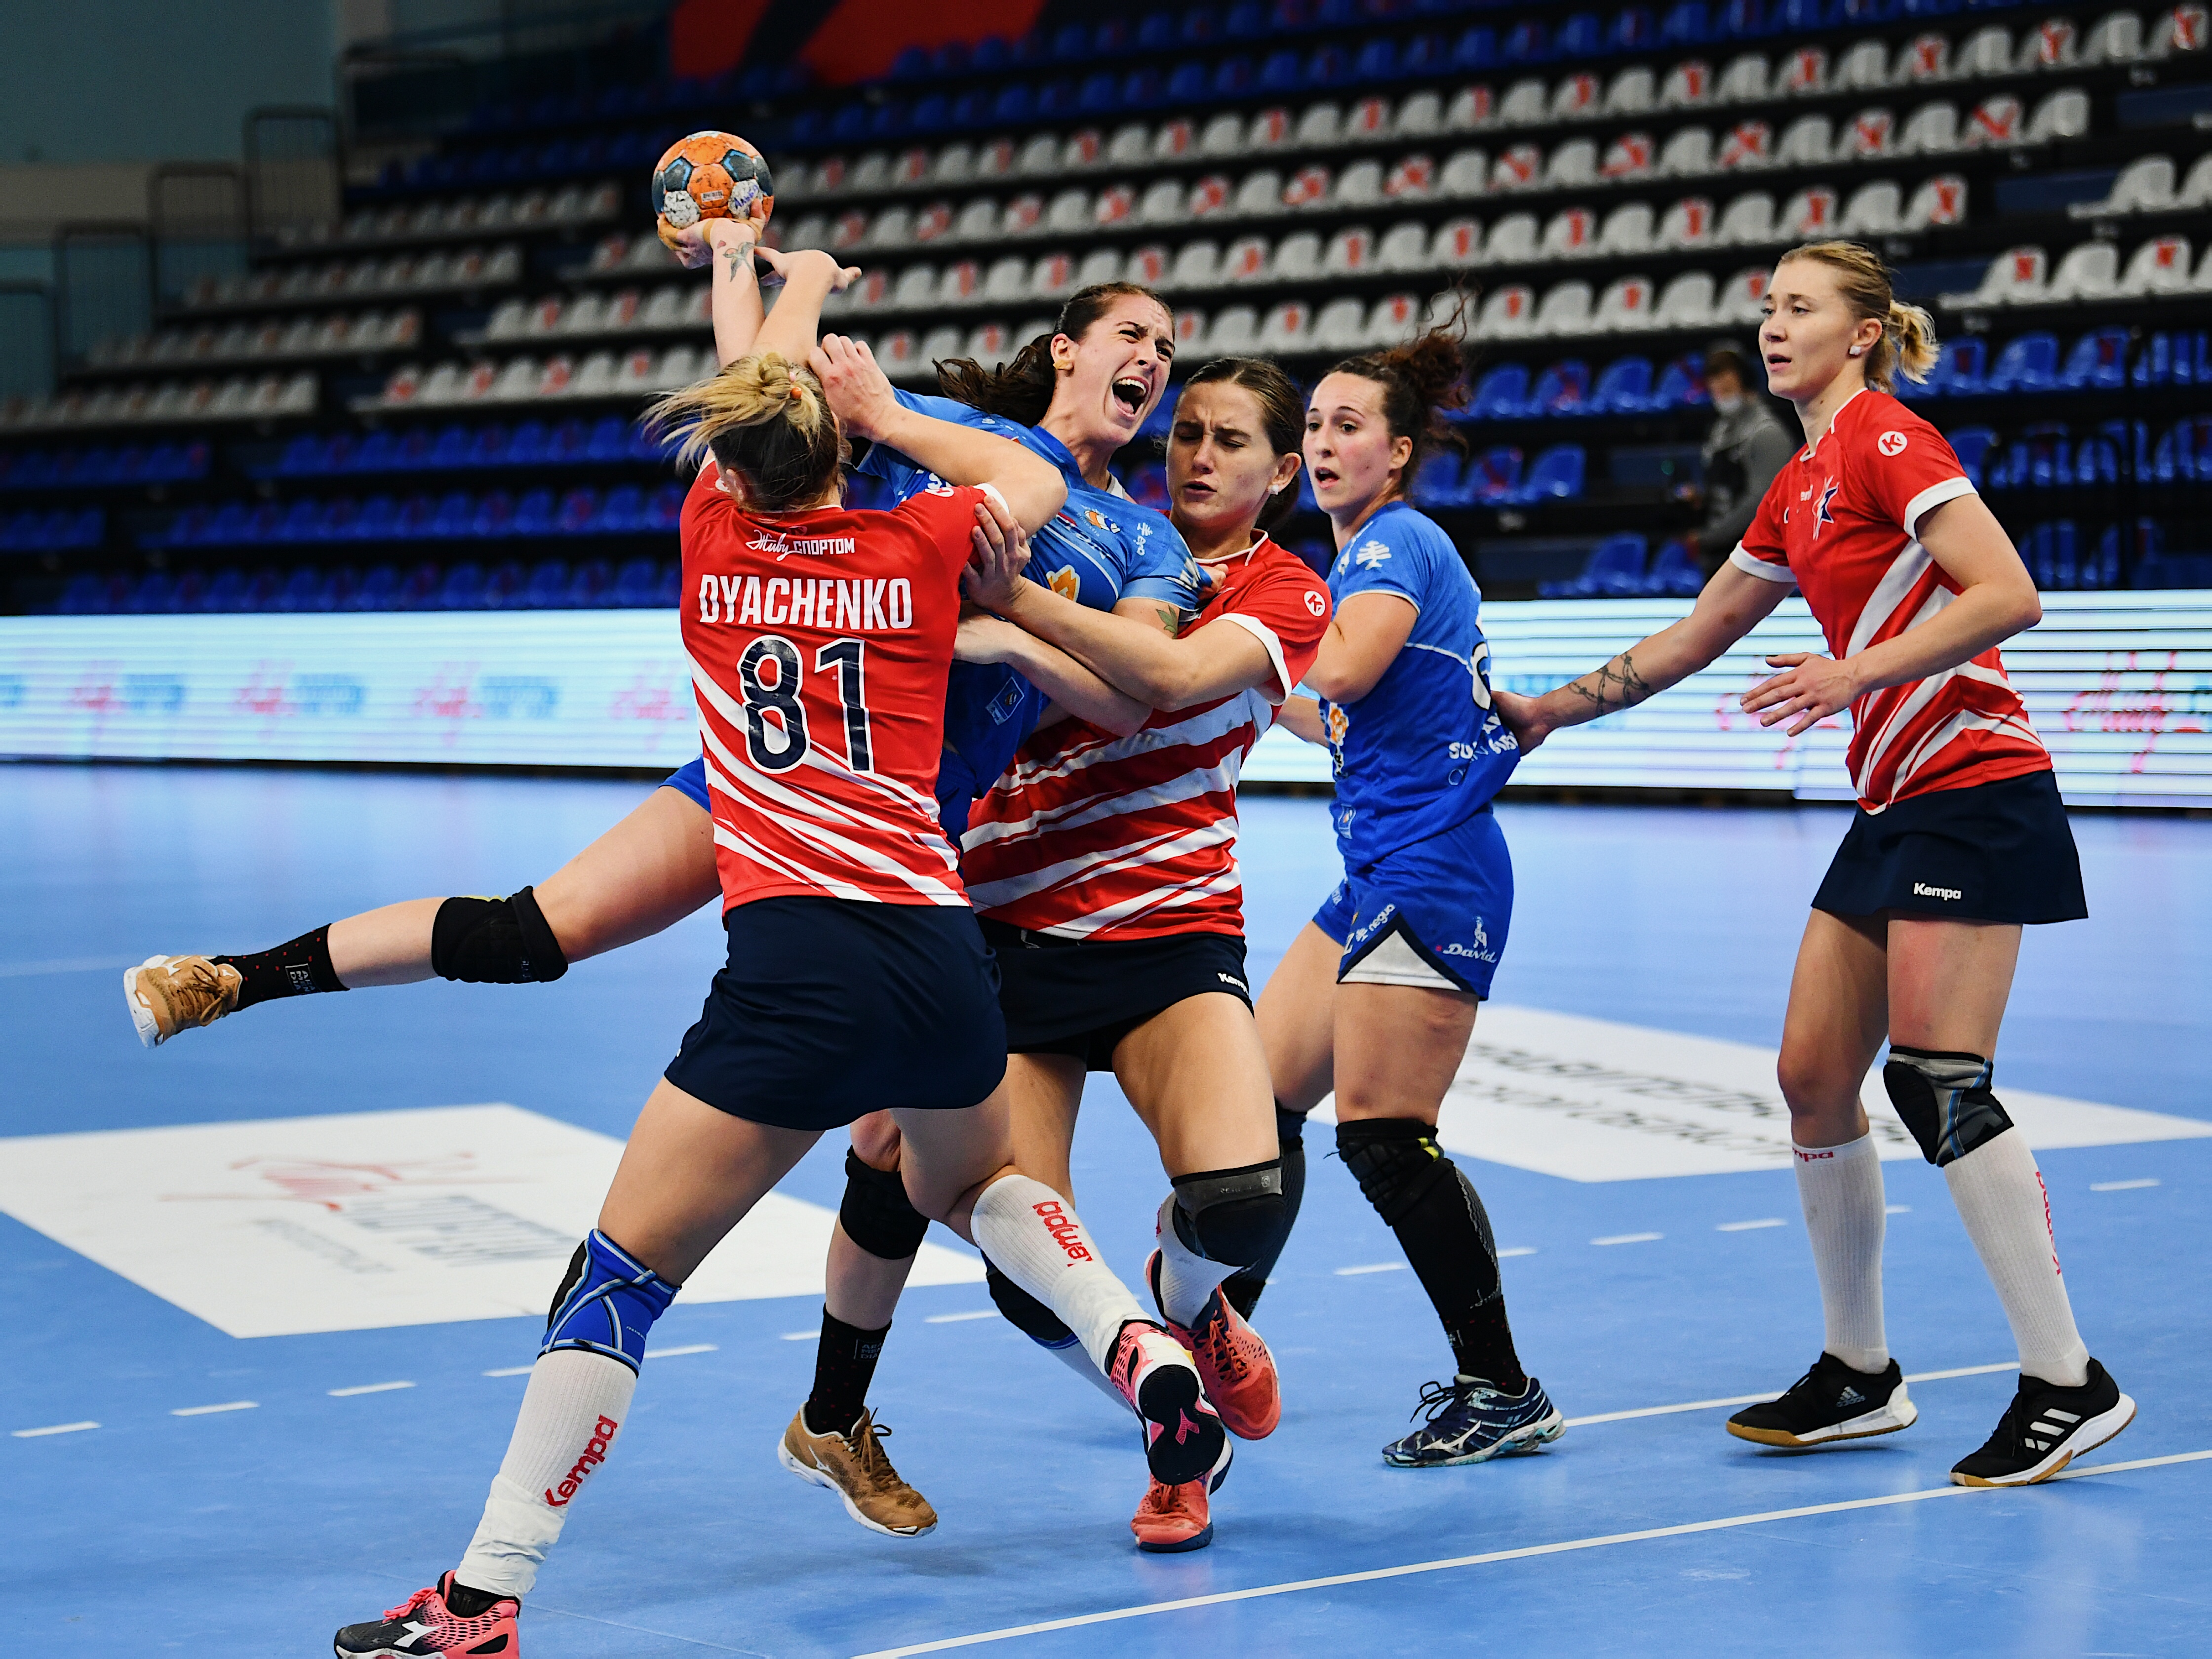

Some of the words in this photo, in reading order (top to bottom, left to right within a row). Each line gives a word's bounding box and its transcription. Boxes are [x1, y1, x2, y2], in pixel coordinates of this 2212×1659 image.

[793, 538, 855, 555] СПОРТОМ
[699, 574, 912, 630] DYACHENKO
[737, 635, 874, 774] 81
[1913, 882, 1962, 901] Kempa
[1442, 943, 1498, 963] David
[1217, 972, 1249, 996] Kemp
[1031, 1201, 1094, 1267] empa
[545, 1414, 618, 1507] Kempa
